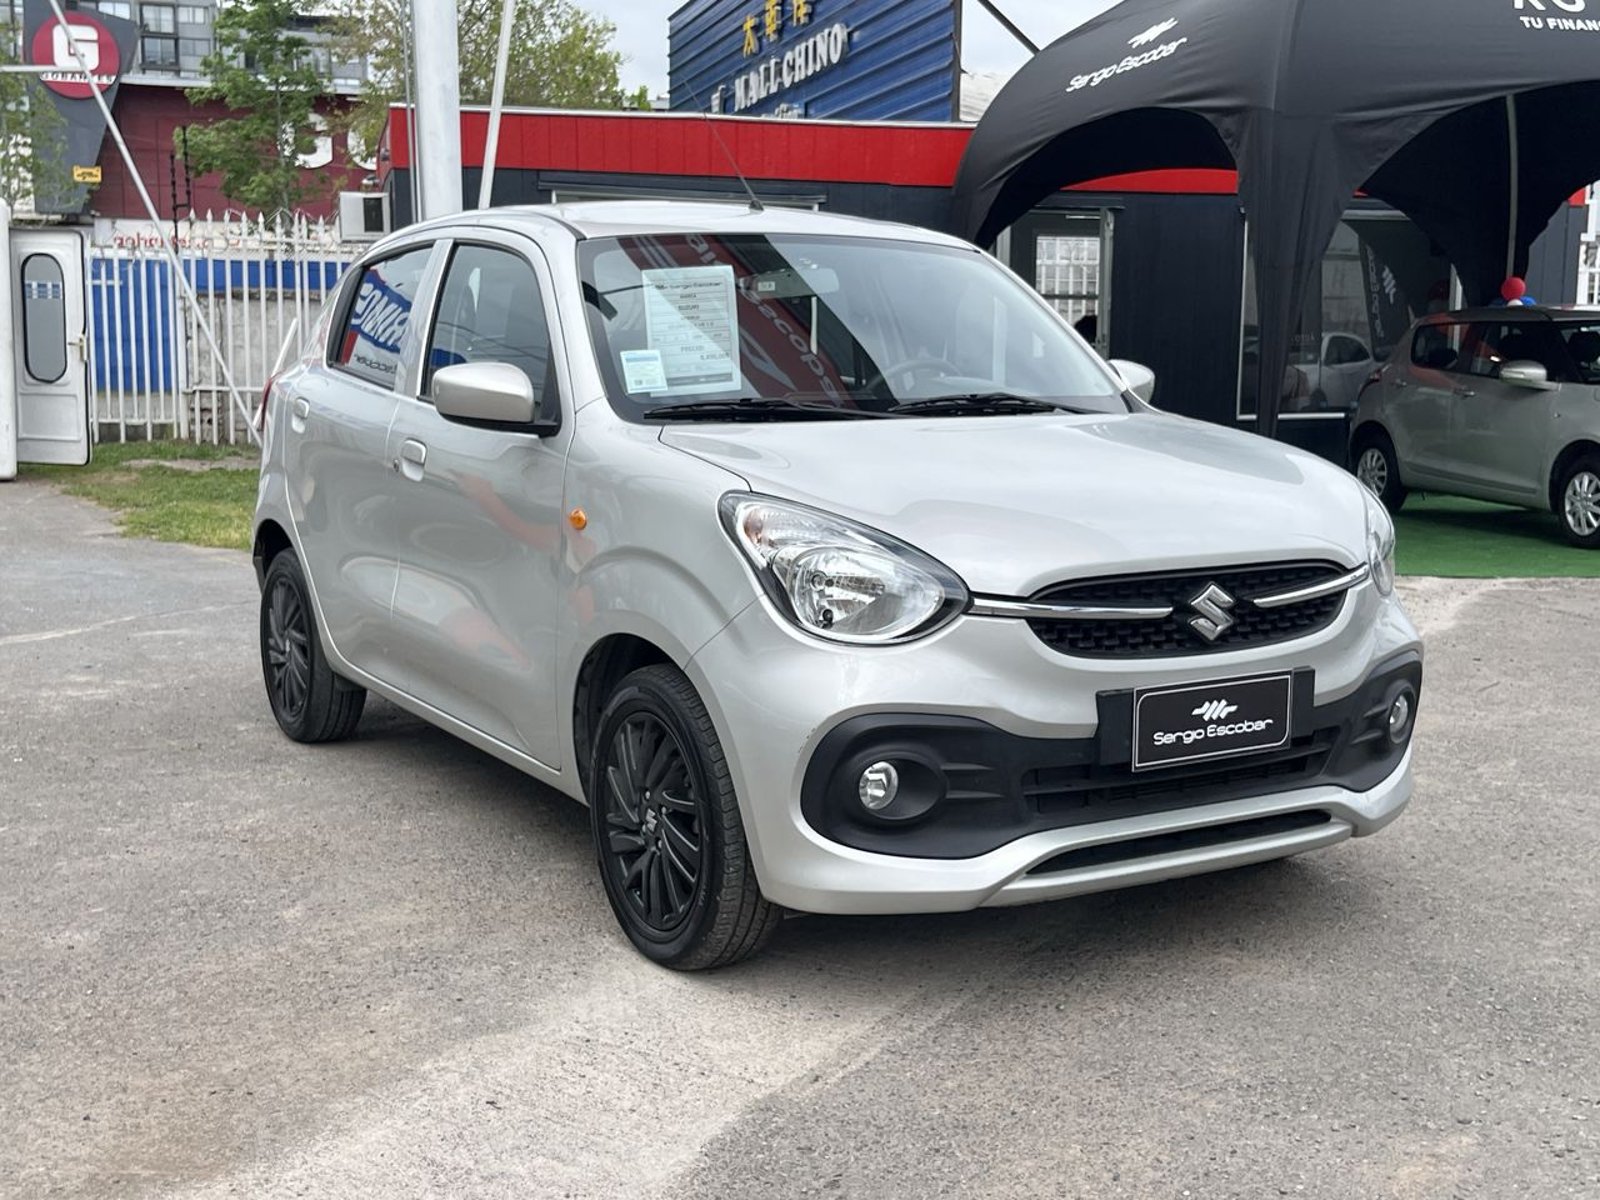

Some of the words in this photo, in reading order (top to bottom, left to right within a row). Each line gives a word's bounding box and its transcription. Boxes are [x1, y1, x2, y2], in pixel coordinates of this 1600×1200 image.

[1519, 16, 1543, 29] TU
[1546, 17, 1600, 31] FINAN
[734, 57, 781, 112] MALL
[782, 23, 848, 89] CHINO
[1065, 64, 1117, 92] Sergo
[1116, 37, 1188, 74] Escobar
[1153, 729, 1206, 746] Sergo
[1206, 718, 1274, 738] Escobar
